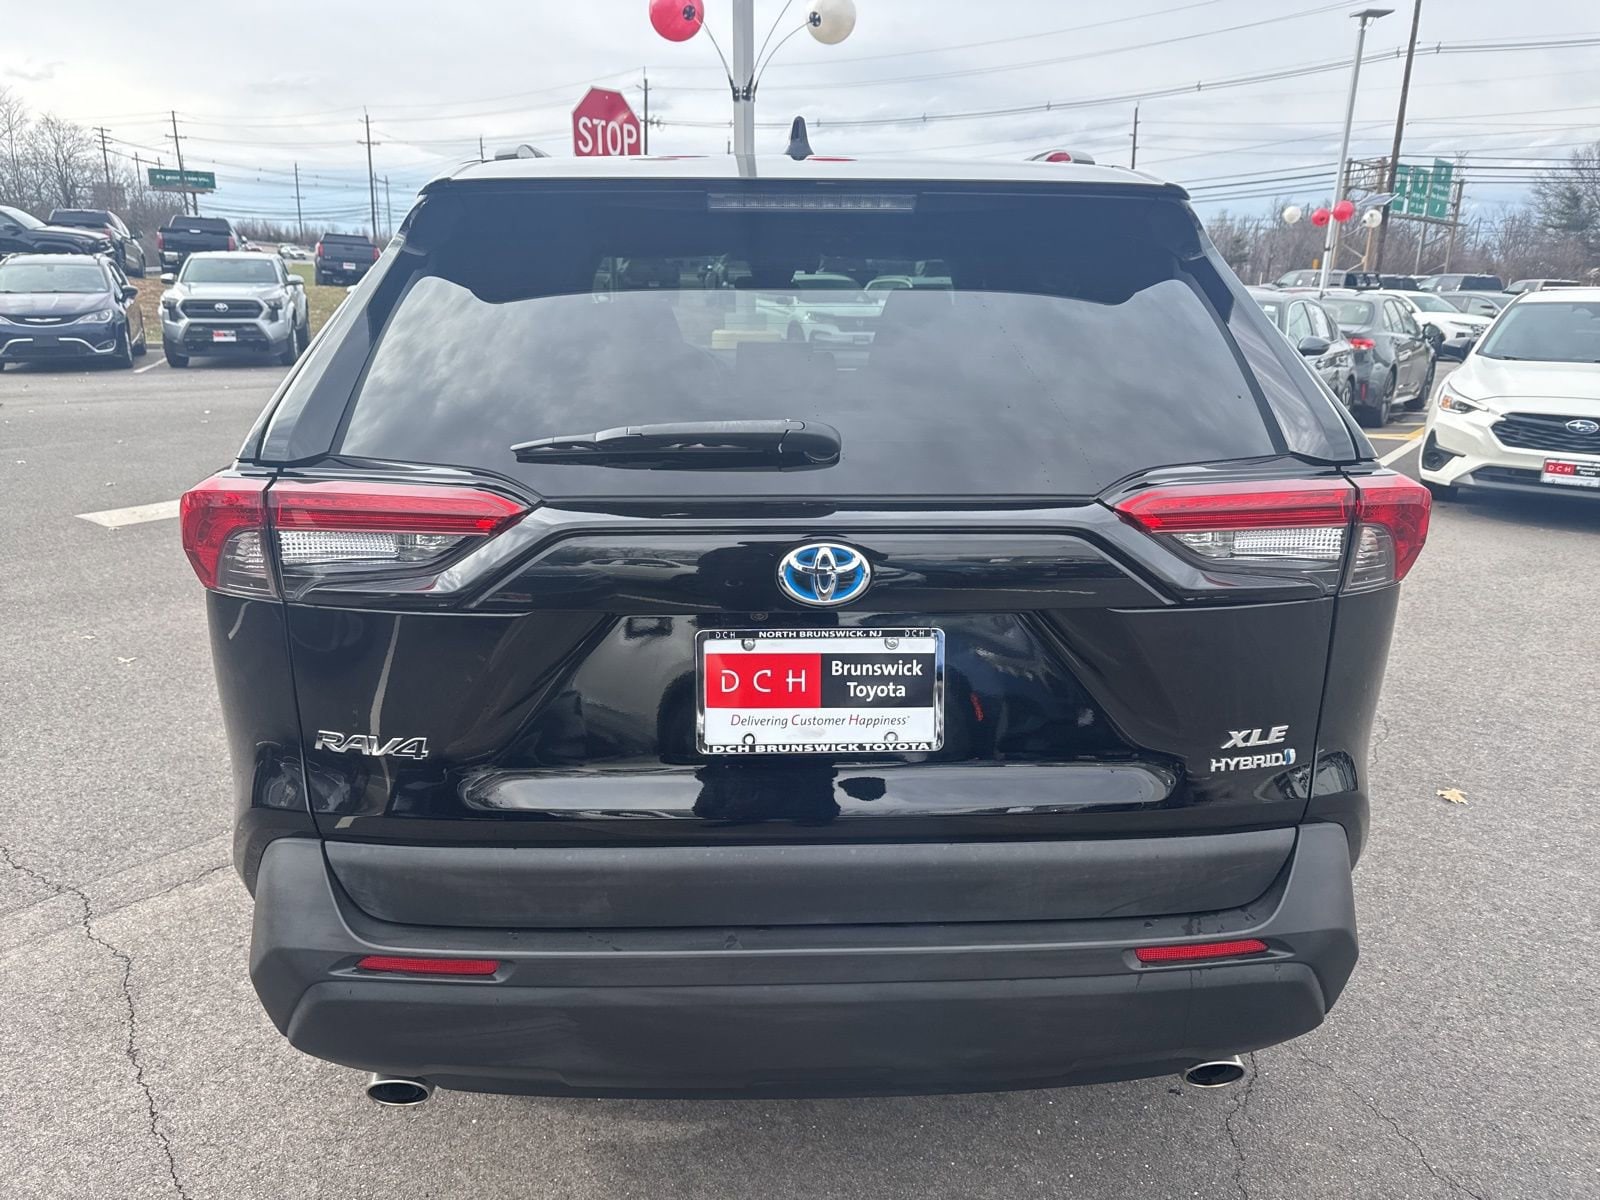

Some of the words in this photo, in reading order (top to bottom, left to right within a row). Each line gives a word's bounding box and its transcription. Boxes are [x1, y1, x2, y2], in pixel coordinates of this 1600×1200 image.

[578, 116, 637, 155] STOP
[758, 630, 796, 638] NORTH
[831, 660, 923, 676] Brunswick
[846, 681, 906, 702] Toyota
[730, 714, 788, 729] Delivering
[791, 714, 846, 727] Customer
[314, 729, 429, 760] RAV4
[1221, 725, 1289, 749] XLE
[712, 744, 750, 753] DCH
[755, 743, 859, 752] BRUNSWICK
[863, 742, 930, 751] TOYOTA
[1210, 753, 1284, 772] HYBRID
